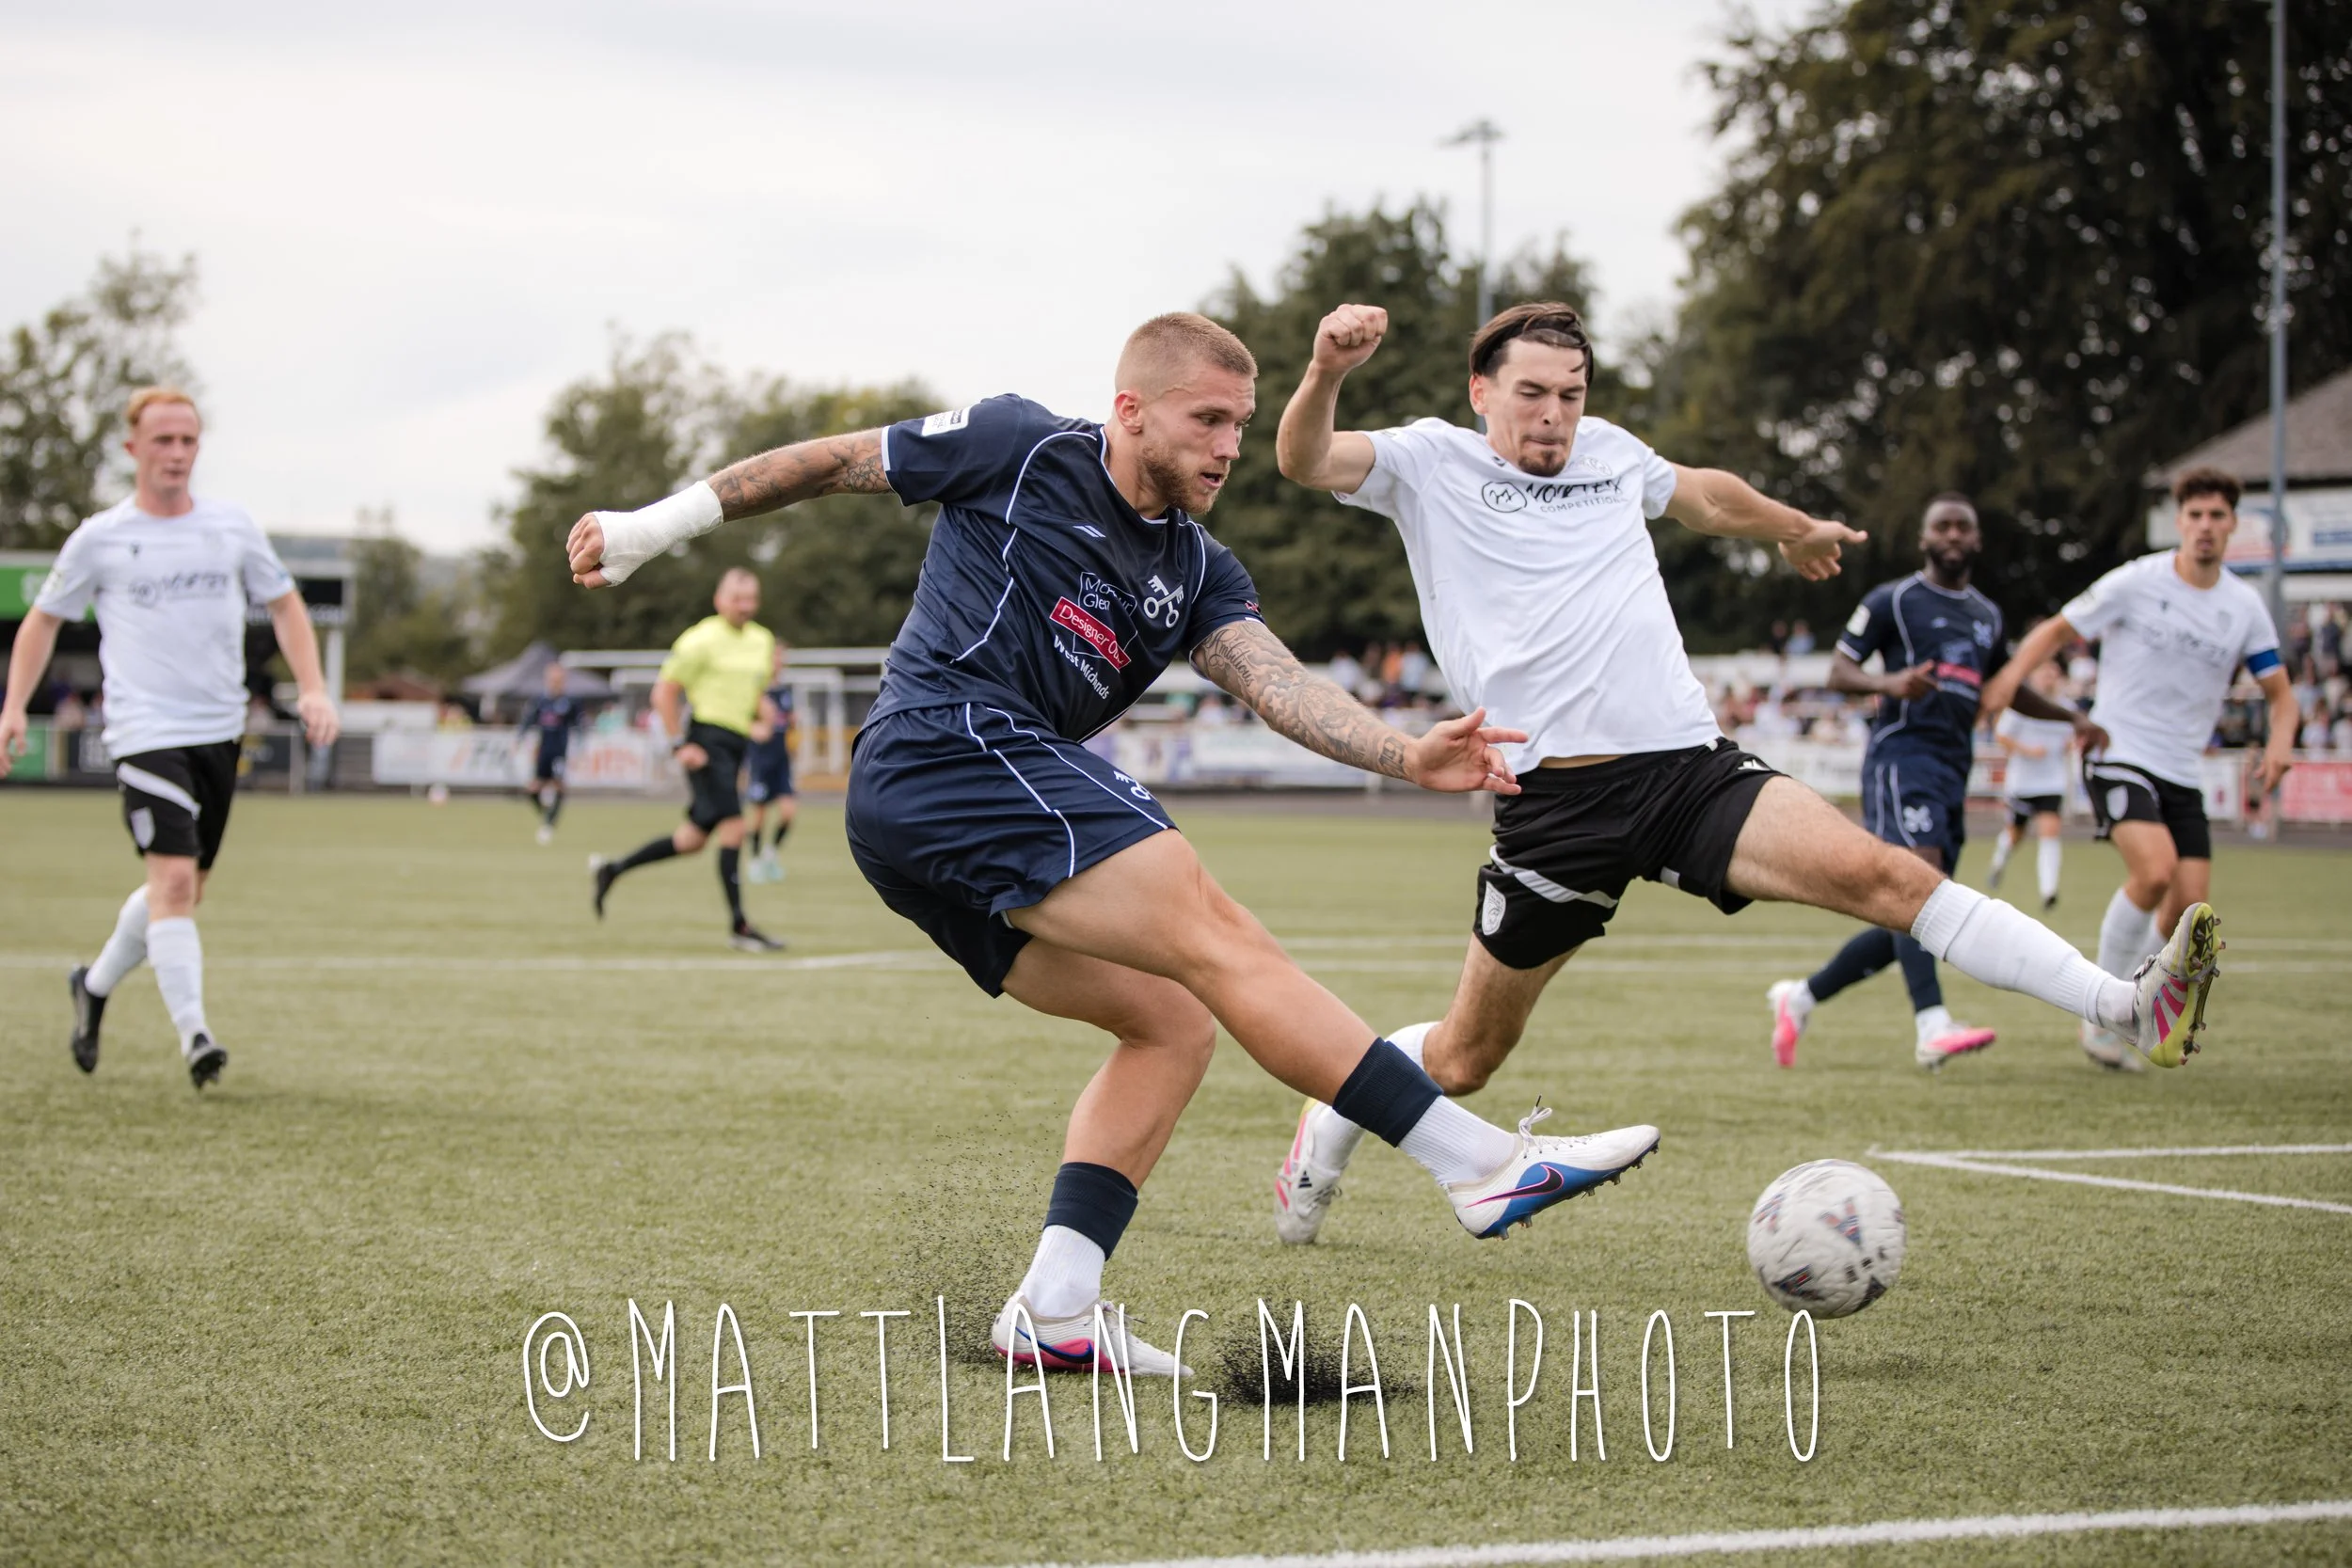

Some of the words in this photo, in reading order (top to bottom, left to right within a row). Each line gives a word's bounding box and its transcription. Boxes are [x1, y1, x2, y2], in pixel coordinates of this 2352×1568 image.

[1083, 594, 1110, 610] Glen
[1058, 604, 1109, 646] Designer
[1053, 634, 1079, 667] West
